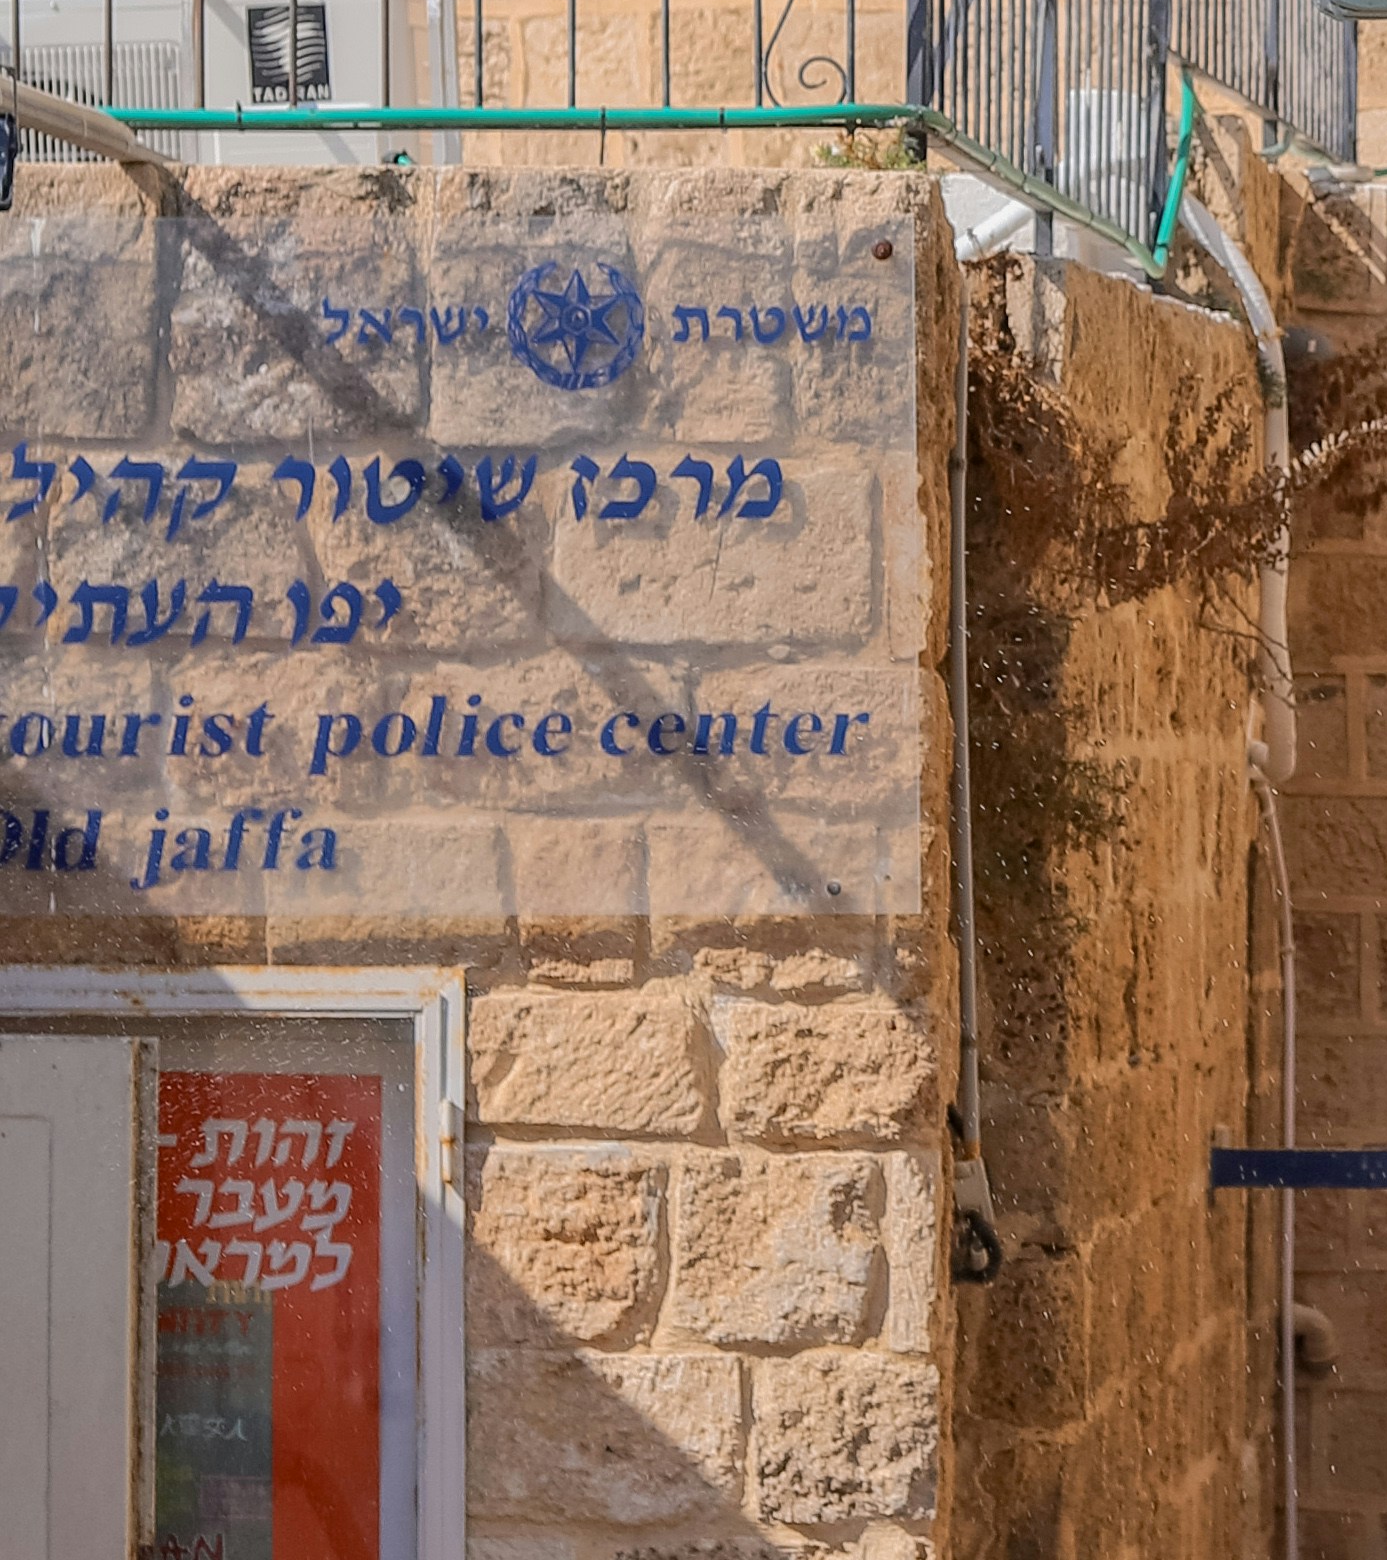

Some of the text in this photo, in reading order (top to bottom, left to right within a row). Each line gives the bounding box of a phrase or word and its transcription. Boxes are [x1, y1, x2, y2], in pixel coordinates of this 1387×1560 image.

[253, 83, 330, 102] TADRAN
[322, 297, 873, 345] משטרת ישראל
[273, 451, 538, 526] שיטור
[571, 451, 786, 522] מרכז
[287, 577, 402, 647] יפו
[308, 695, 573, 776] police
[600, 698, 871, 759] center
[130, 808, 340, 891] jaffa
[189, 1117, 357, 1170] זהות
[175, 1177, 353, 1233] מעבר
